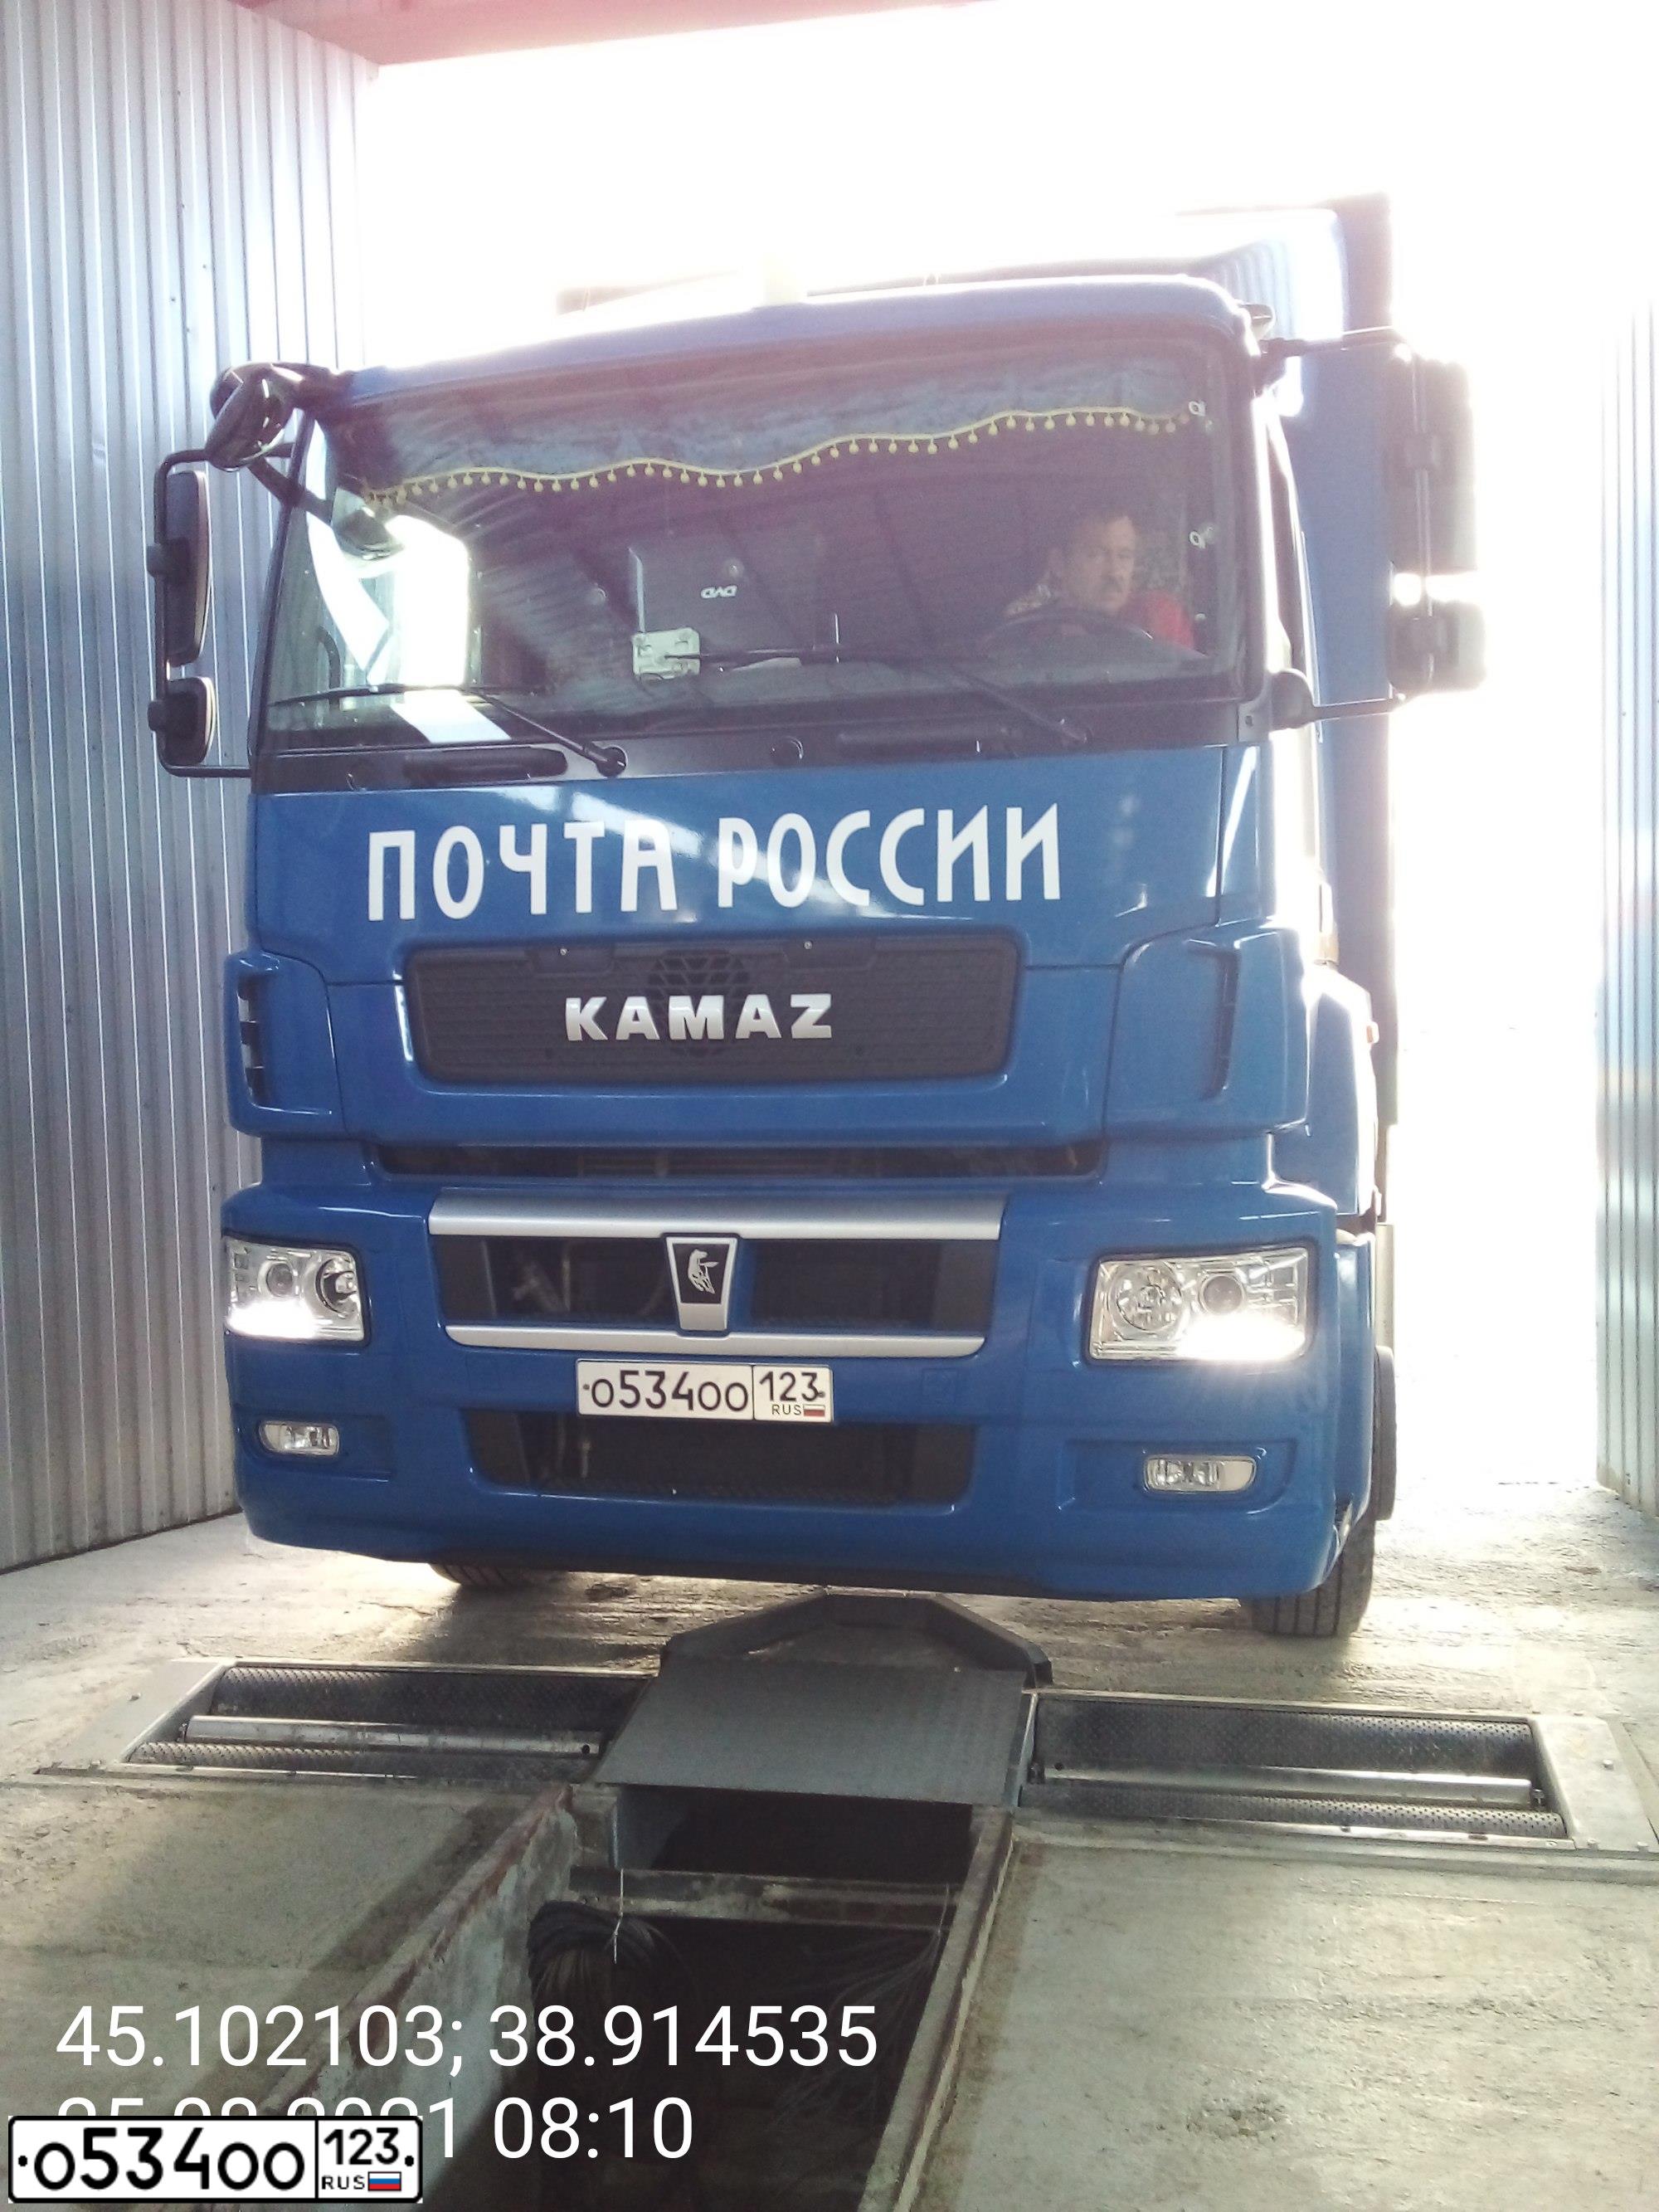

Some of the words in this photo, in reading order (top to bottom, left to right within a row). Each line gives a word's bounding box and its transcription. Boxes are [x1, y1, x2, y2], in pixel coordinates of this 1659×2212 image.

[367, 820, 678, 921] ПОЧТА
[717, 803, 1061, 909] РОССИИ
[565, 993, 832, 1041] KAMAZ
[759, 1371, 820, 1402] 123
[771, 1404, 802, 1415] RUS
